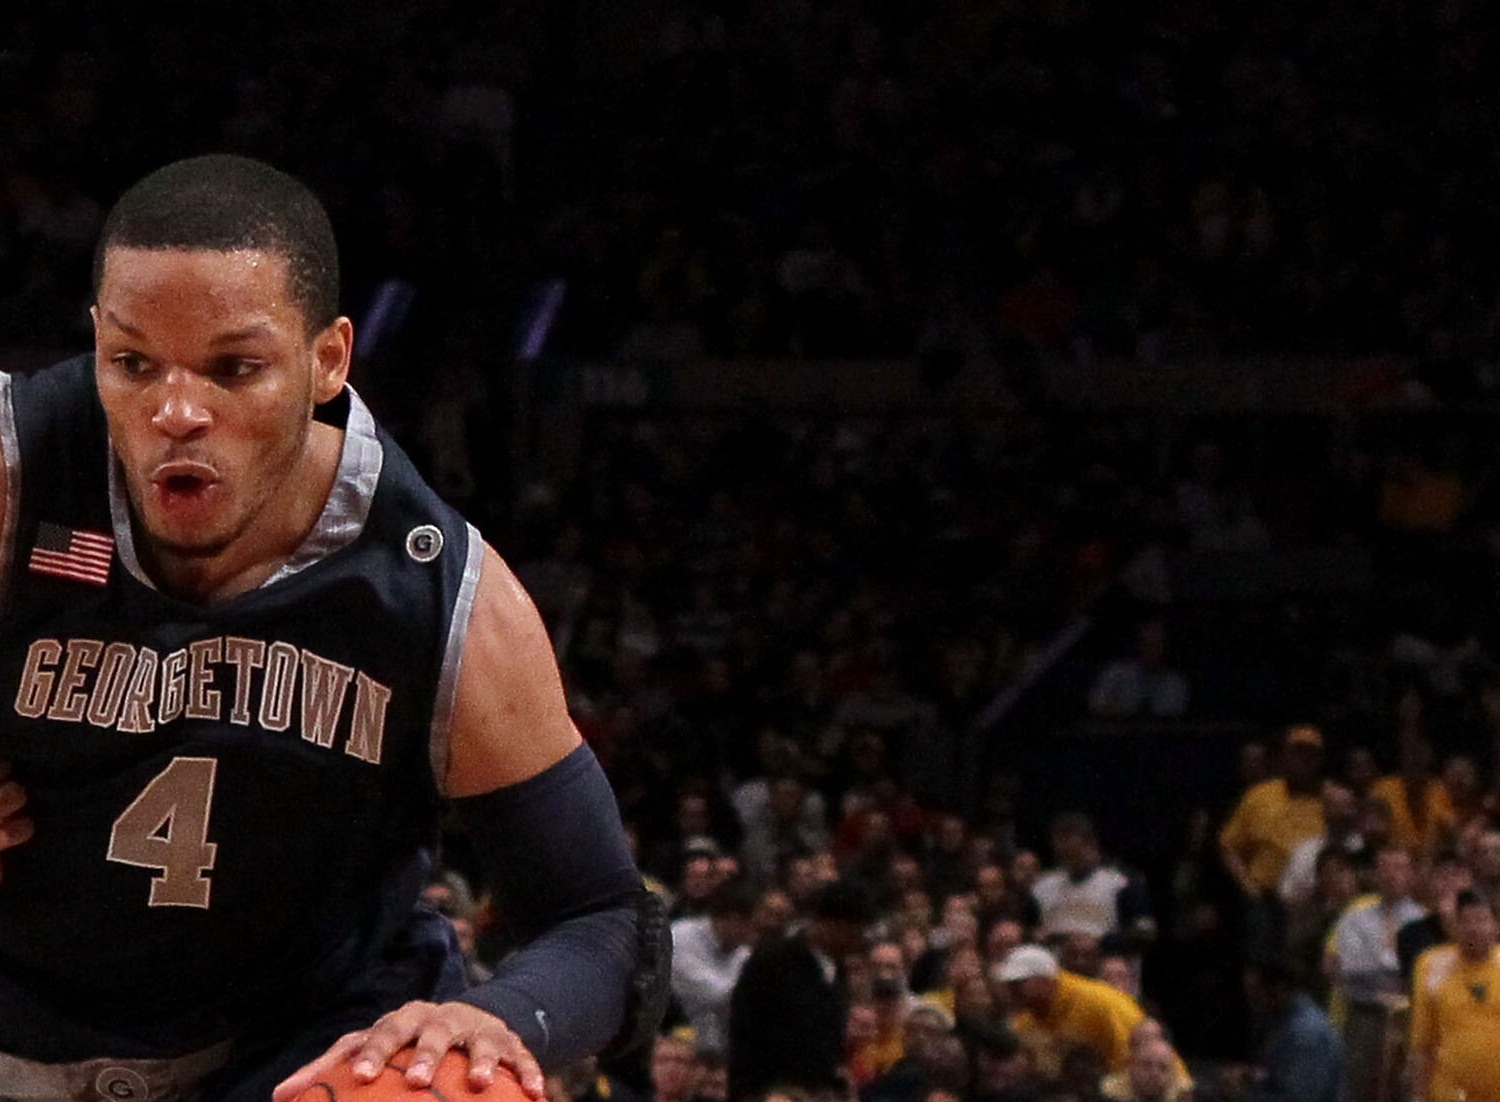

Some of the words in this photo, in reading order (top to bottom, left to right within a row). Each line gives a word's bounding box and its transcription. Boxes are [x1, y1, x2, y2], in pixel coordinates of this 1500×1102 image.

[14, 636, 393, 765] GEORGETOWN
[106, 756, 218, 909] 4
[108, 1079, 134, 1099] G
